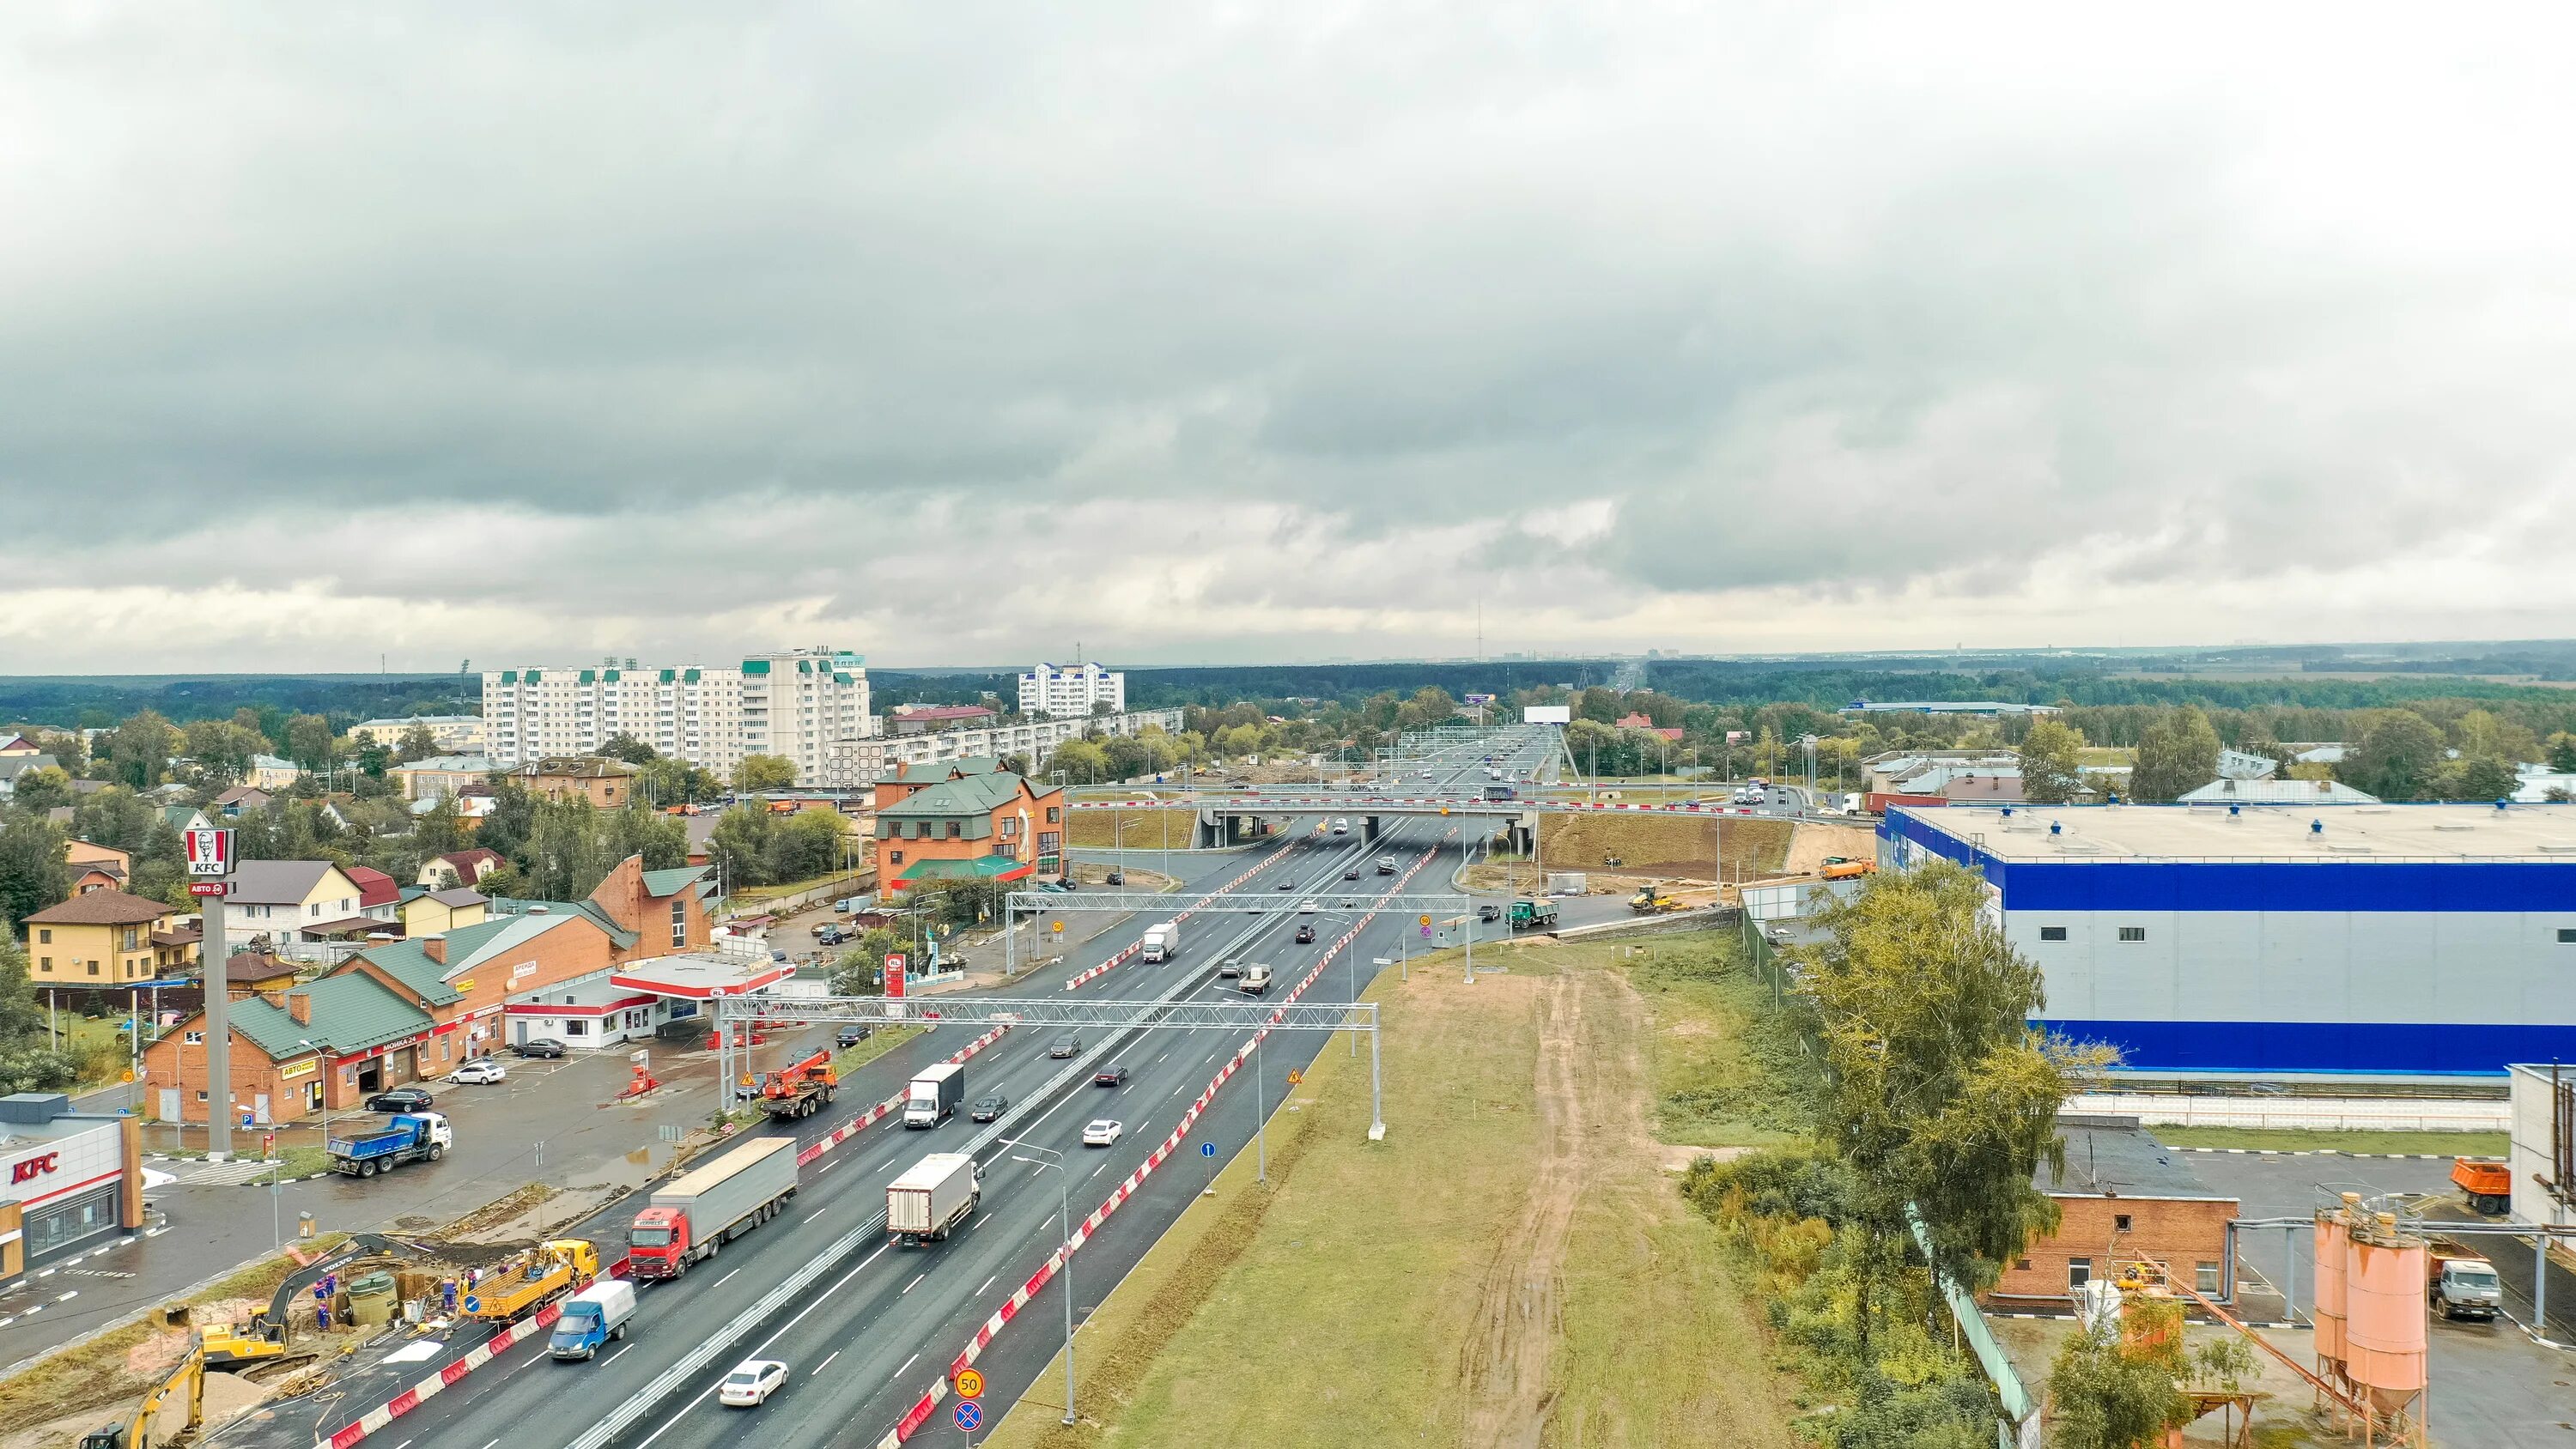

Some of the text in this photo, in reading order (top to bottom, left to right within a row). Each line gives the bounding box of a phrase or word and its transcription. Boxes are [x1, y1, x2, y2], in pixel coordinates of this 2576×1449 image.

[194, 863, 219, 873] KFC
[408, 1035, 416, 1044] 24
[284, 1064, 301, 1076] АВТО
[11, 1151, 59, 1185] KFC
[321, 1256, 353, 1272] VOLVO
[64, 1269, 137, 1278] СПАСИБО
[962, 1379, 977, 1391] 50
